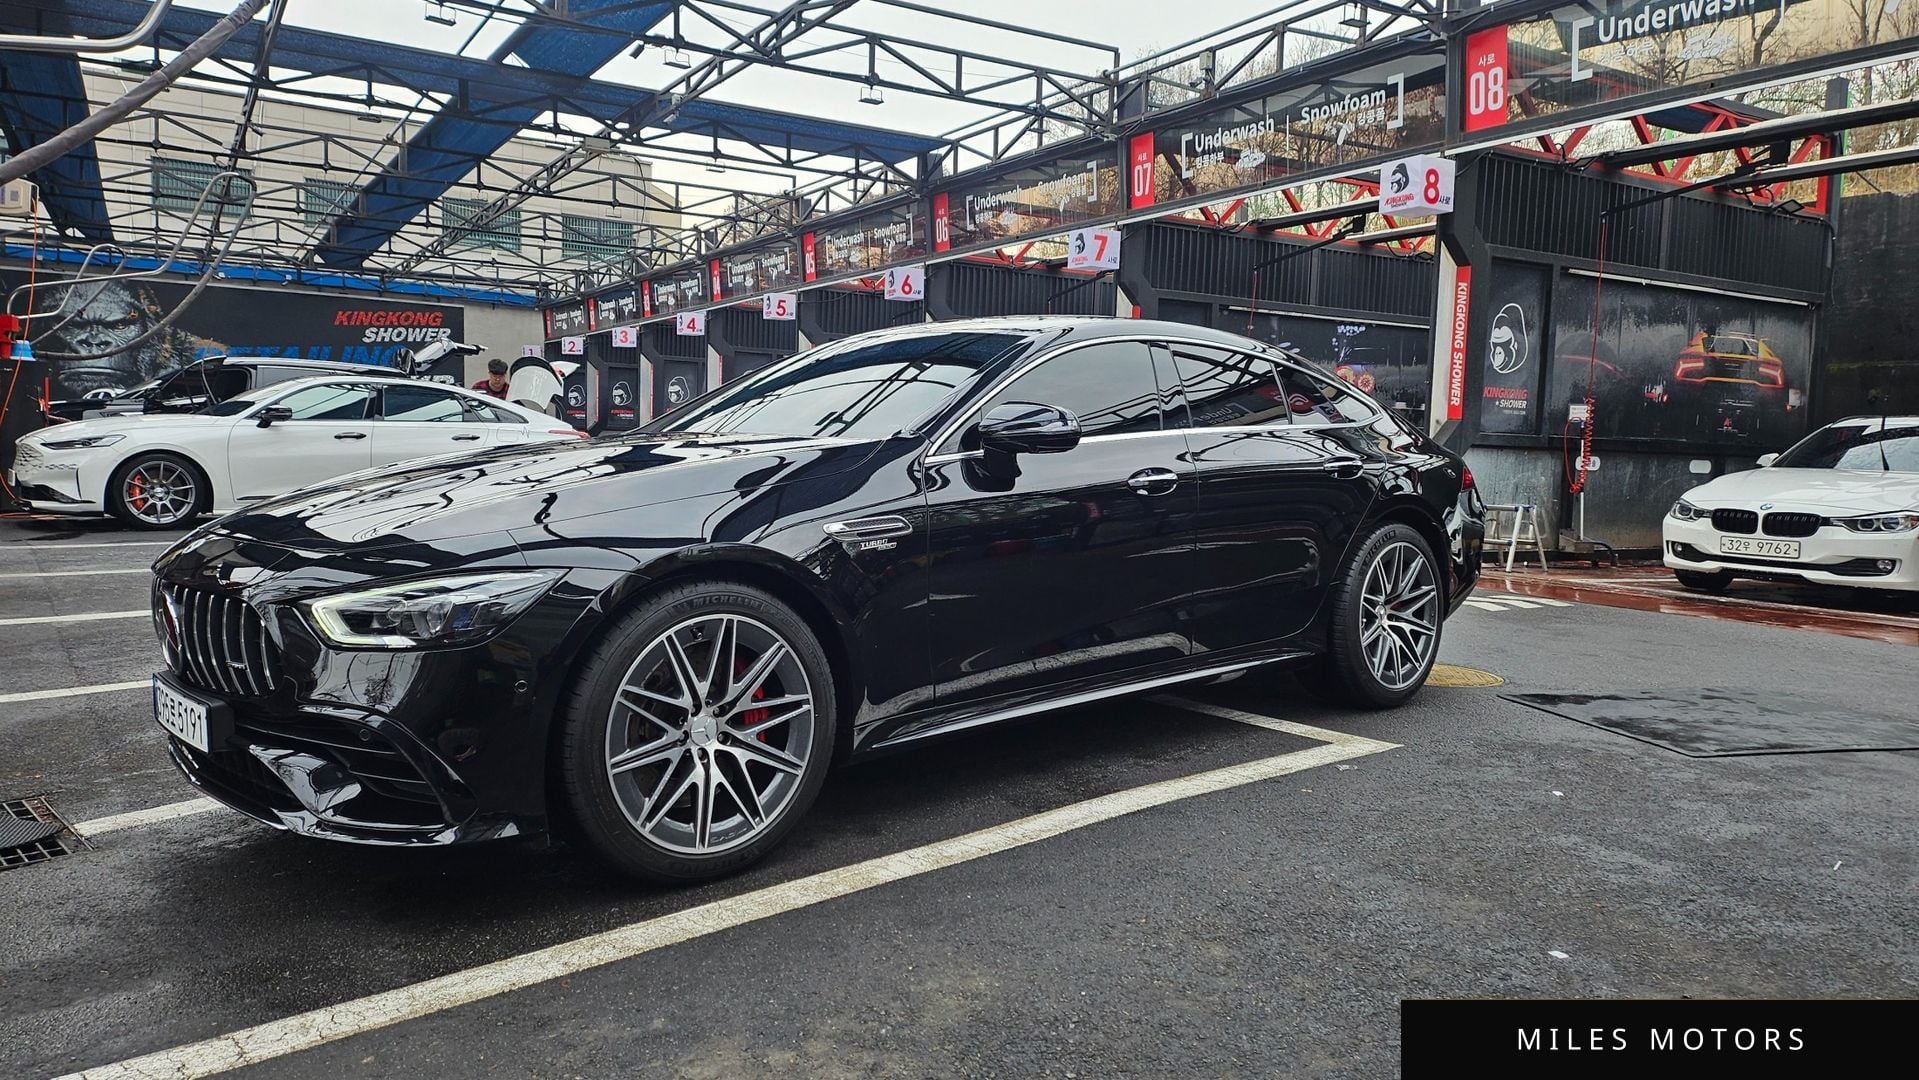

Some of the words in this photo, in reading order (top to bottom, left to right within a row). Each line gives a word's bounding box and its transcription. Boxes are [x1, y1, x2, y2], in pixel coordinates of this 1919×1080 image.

[1598, 0, 1754, 42] Underwas
[1478, 53, 1495, 66] 사로
[1470, 67, 1504, 115] 08
[1194, 118, 1275, 152] Underwash
[1300, 89, 1386, 124] Snowfoam
[1135, 162, 1152, 196] 07
[1424, 168, 1440, 205] 8
[974, 185, 1022, 210] Underwash
[1038, 173, 1087, 192] Snowfoam
[833, 232, 865, 248] Underwash
[873, 222, 907, 239] Snowfoam
[935, 217, 948, 243] 06
[1094, 233, 1108, 262] 7
[805, 252, 815, 274] 05
[901, 274, 913, 295] 6
[334, 311, 443, 326] KINGKONG
[775, 299, 787, 317] 5
[1454, 282, 1468, 349] KINGKONG
[362, 327, 451, 343] SHOWER
[686, 317, 697, 332] 4
[567, 341, 577, 353] 2
[619, 330, 629, 344] 3
[1450, 352, 1463, 406] SHOWER
[1483, 387, 1528, 399] KINGKONG
[1500, 399, 1528, 409] SHOWER
[1727, 539, 1751, 551] 32우
[1757, 541, 1791, 555] 9762
[178, 700, 203, 745] 5191
